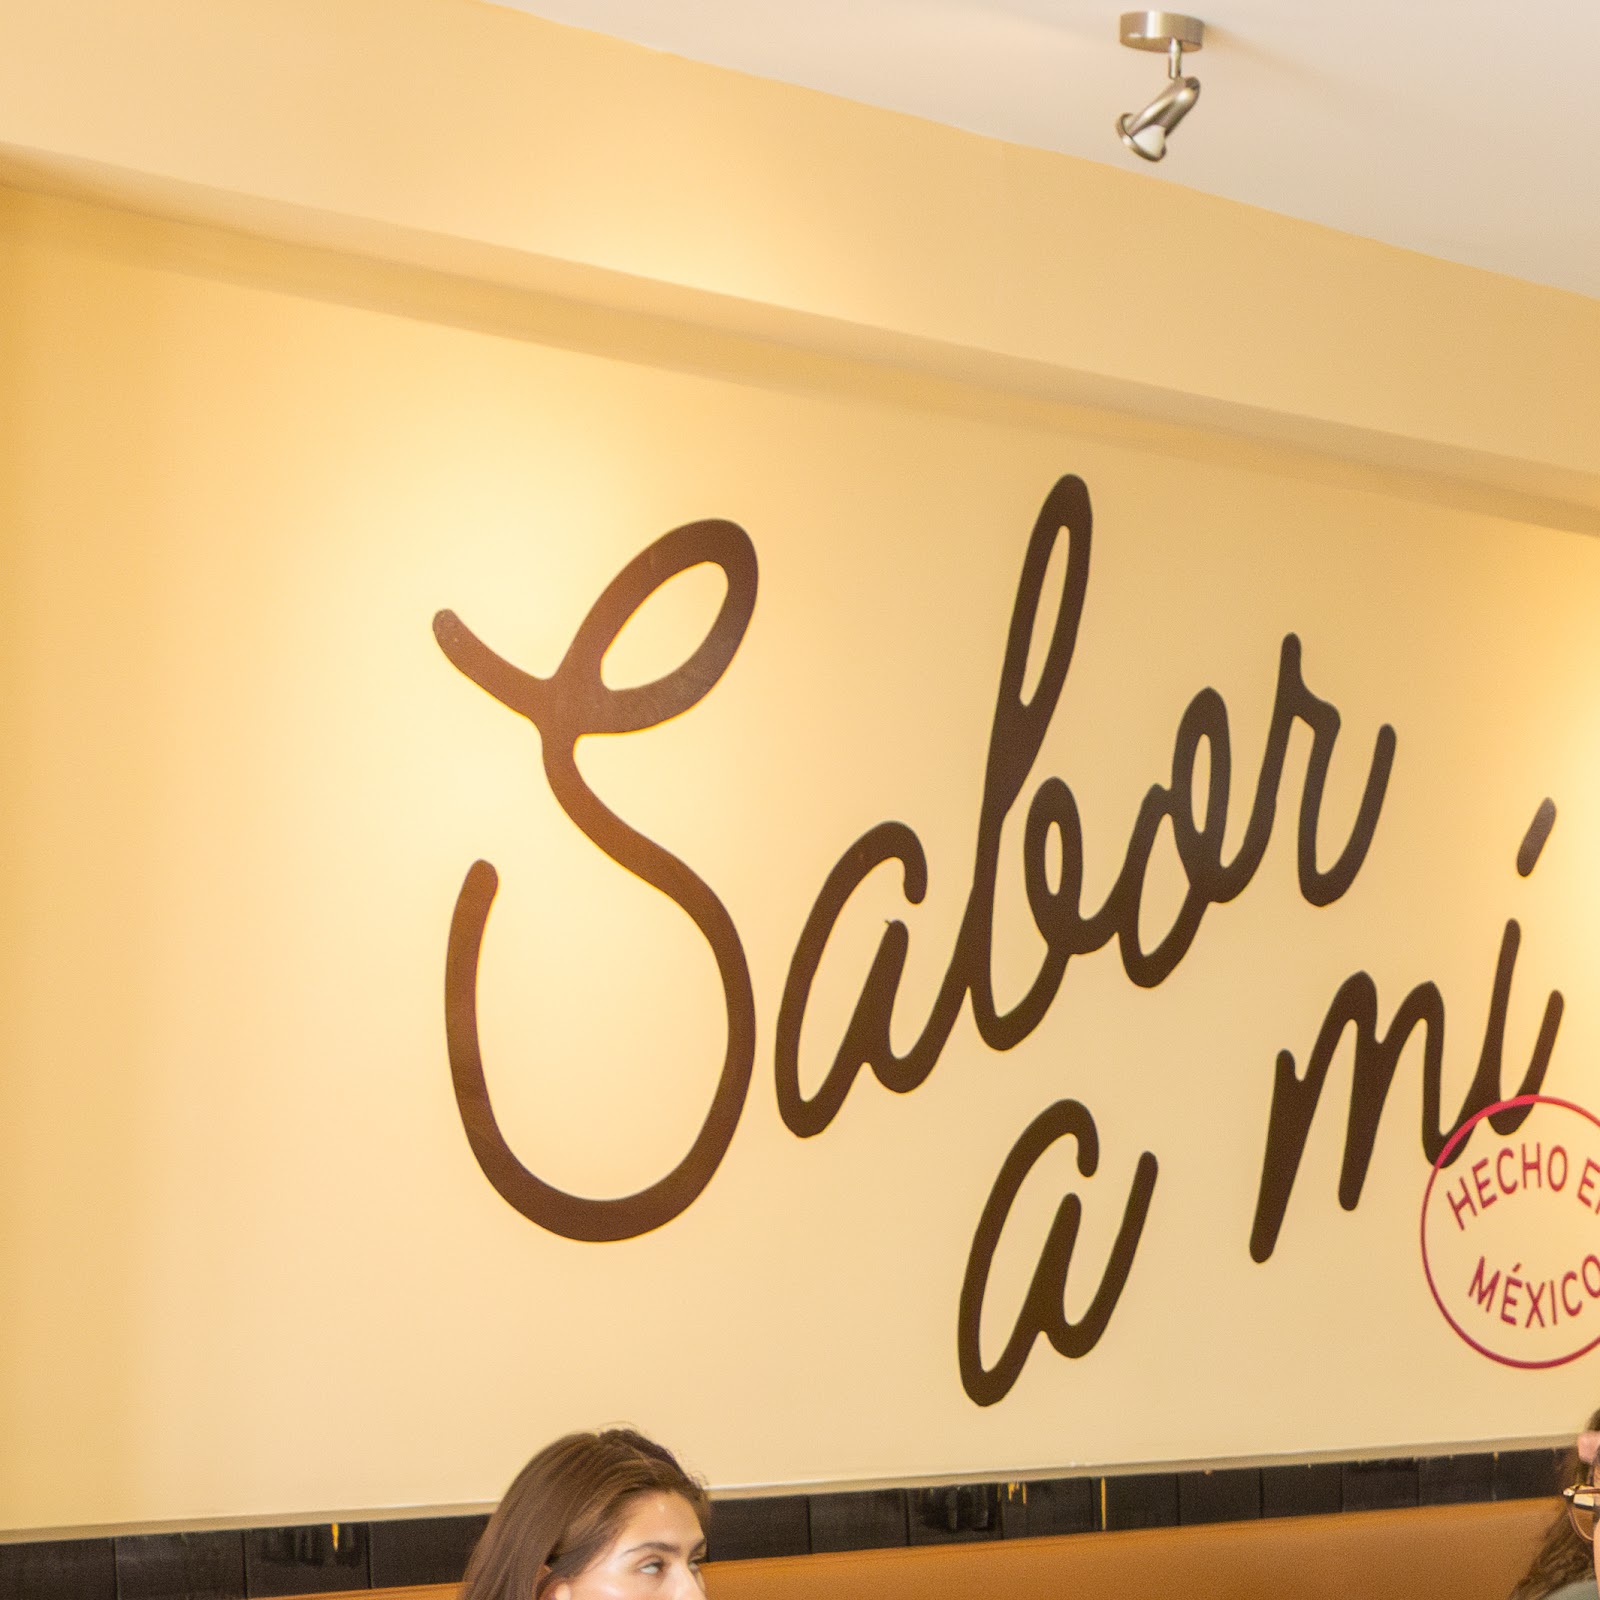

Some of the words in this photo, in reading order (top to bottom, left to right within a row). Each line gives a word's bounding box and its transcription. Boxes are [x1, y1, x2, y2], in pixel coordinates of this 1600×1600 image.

[432, 474, 1396, 1243] Sabor
[957, 1098, 1158, 1407] a
[1250, 797, 1564, 1264] mí
[1446, 1142, 1568, 1231] HECHO
